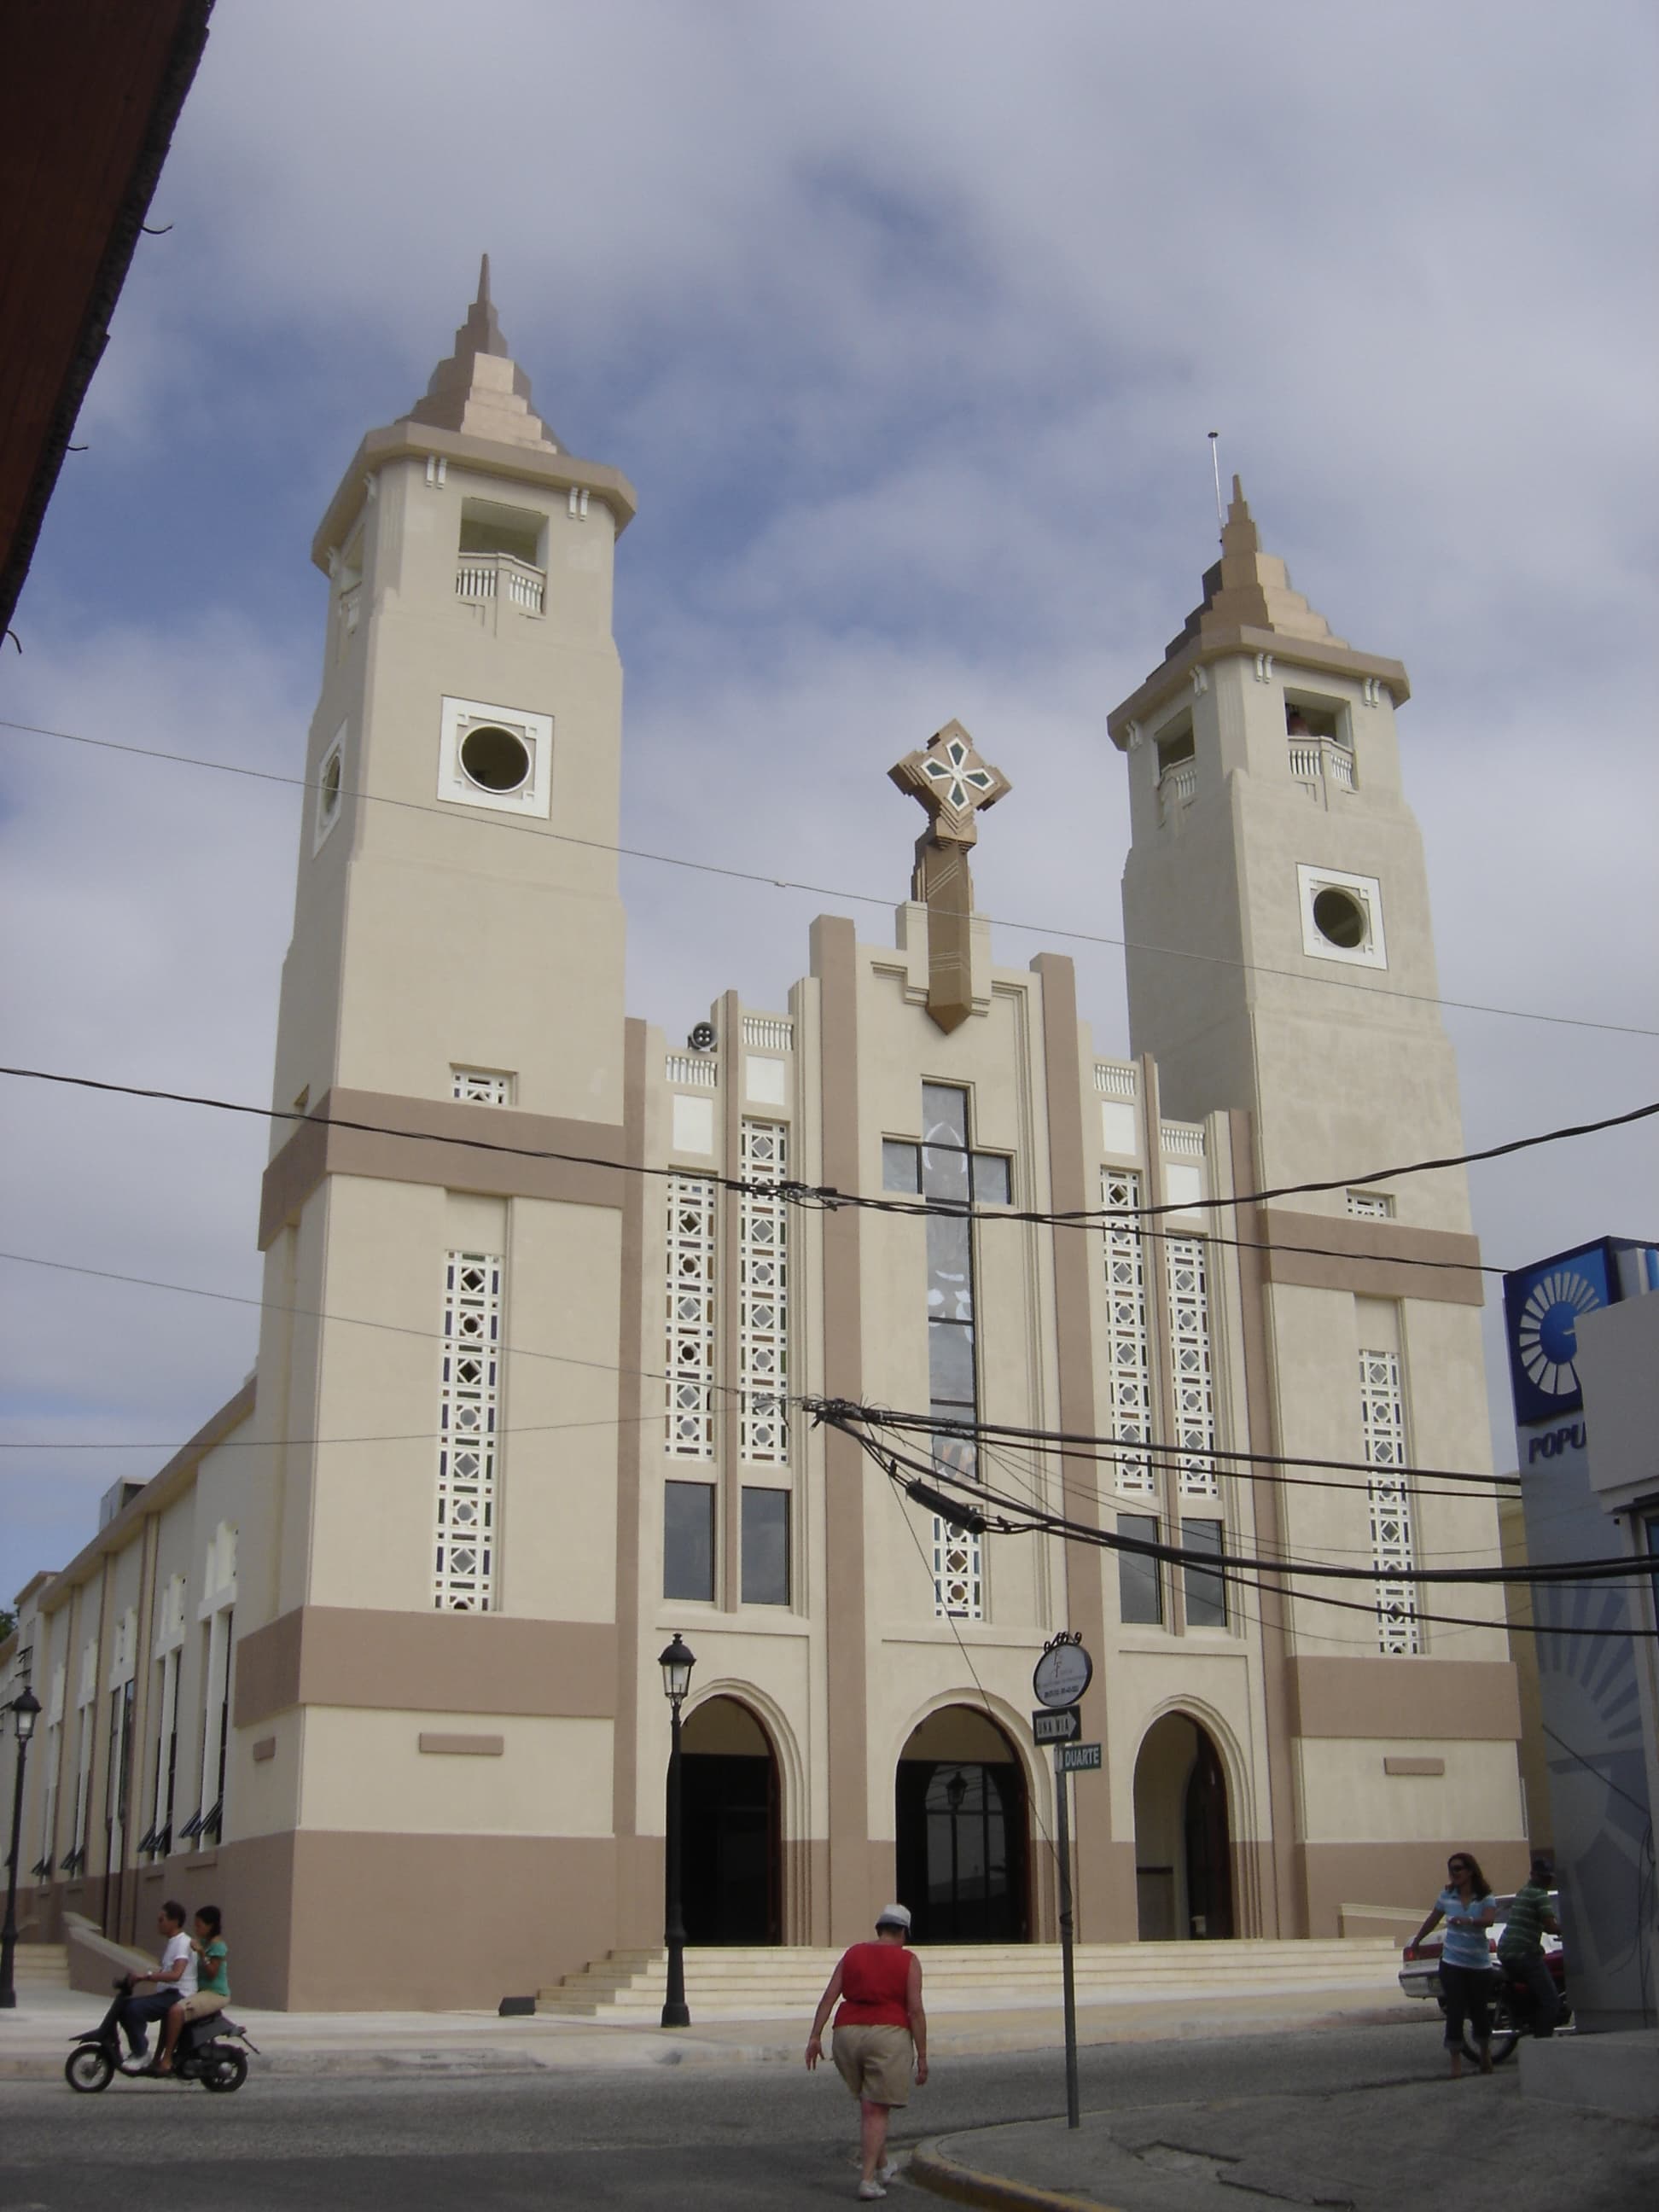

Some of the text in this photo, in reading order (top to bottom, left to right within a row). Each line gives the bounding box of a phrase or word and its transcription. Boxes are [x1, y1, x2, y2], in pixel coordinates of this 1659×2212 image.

[1528, 1421, 1586, 1463] POPU
[1038, 1719, 1052, 1735] UNA
[1065, 1747, 1099, 1767] DUARTE
